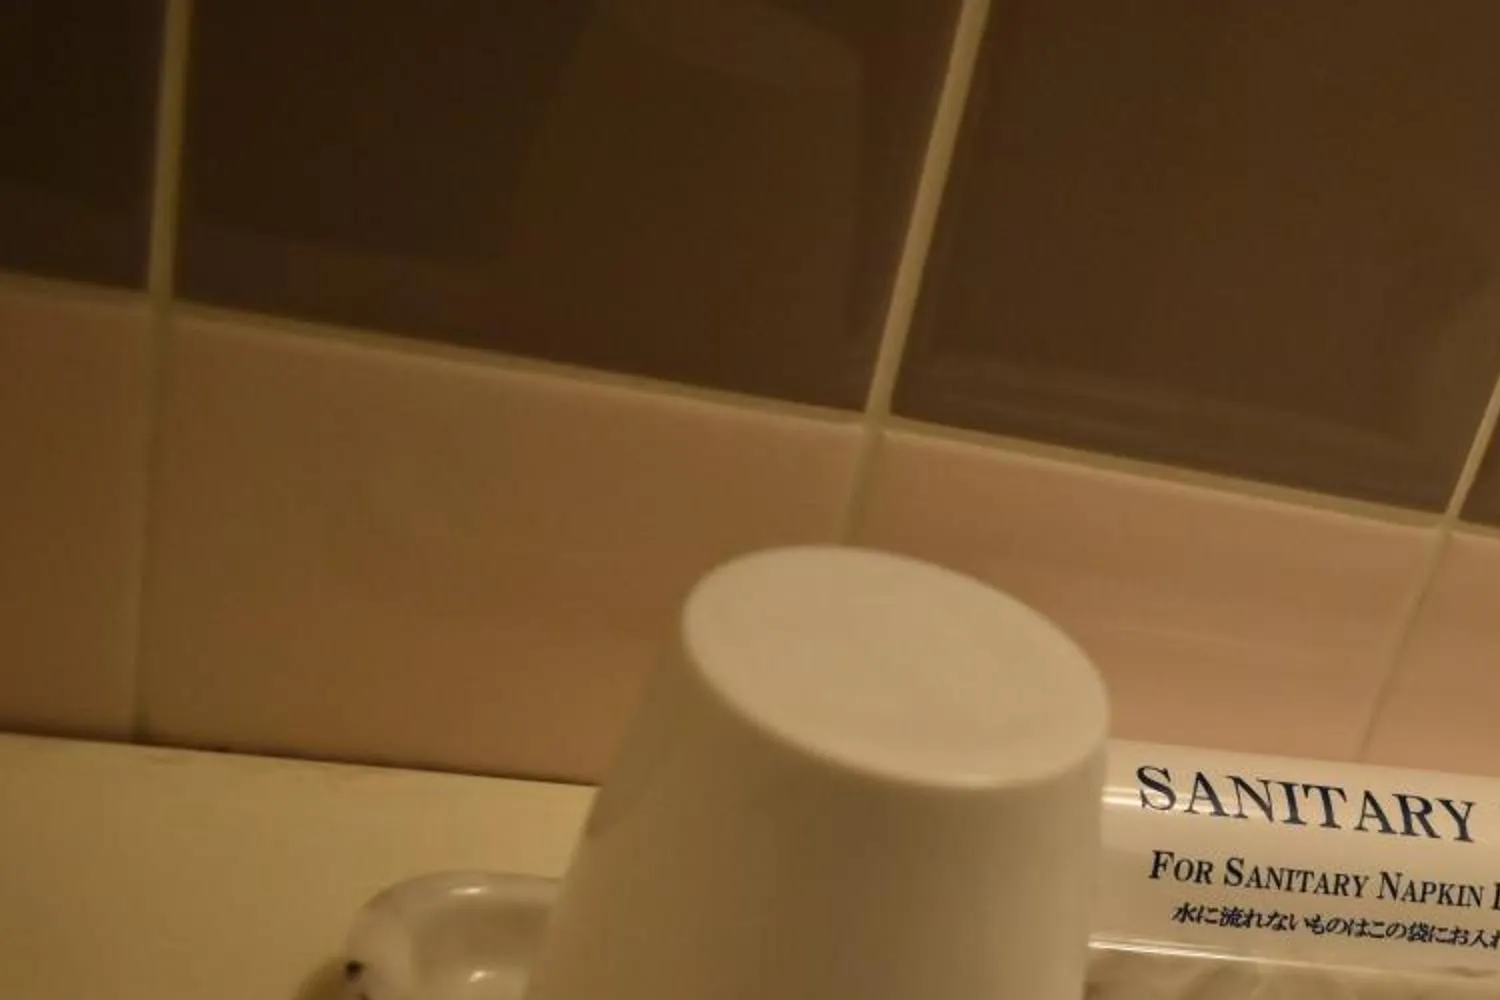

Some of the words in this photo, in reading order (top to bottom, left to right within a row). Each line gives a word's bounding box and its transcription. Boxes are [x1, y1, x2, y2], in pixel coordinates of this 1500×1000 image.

[1136, 765, 1477, 843] SANITARY
[1148, 849, 1214, 885] FOR
[1223, 857, 1370, 898] SANITARY
[1376, 870, 1485, 908] NAPKIN
